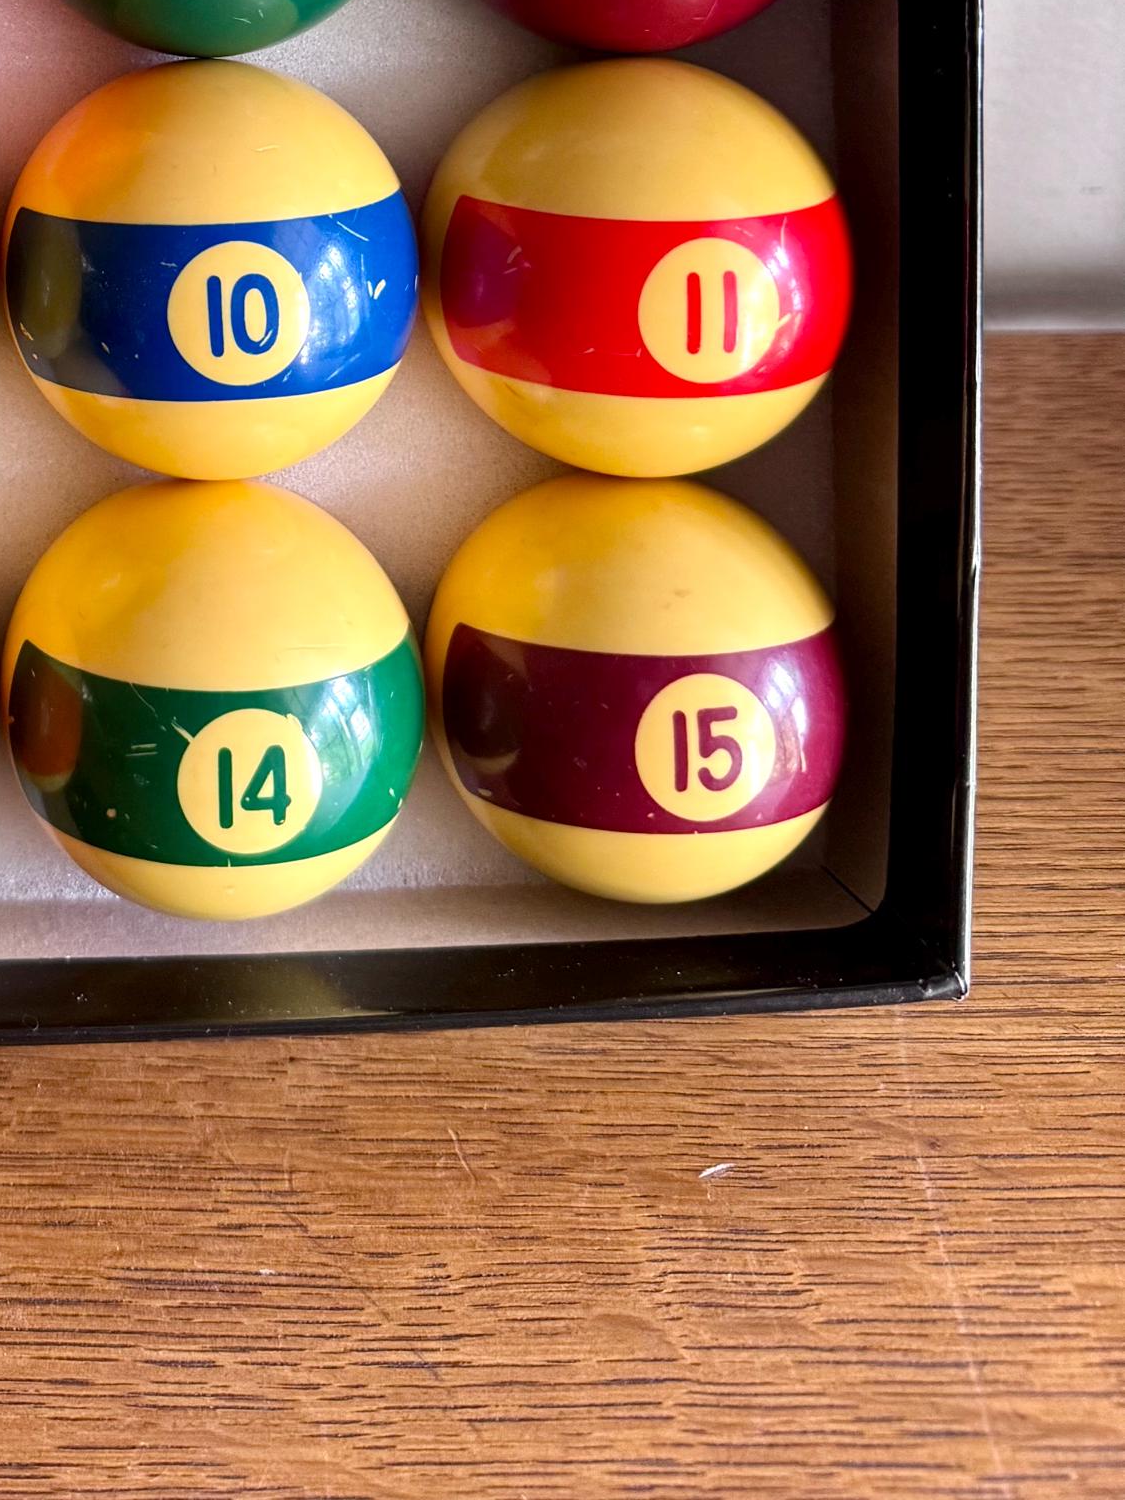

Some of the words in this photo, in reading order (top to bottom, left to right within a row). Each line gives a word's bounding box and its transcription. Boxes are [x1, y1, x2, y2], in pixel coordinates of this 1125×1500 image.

[206, 272, 280, 357] 10
[685, 270, 737, 354] 11
[217, 745, 292, 829] 14
[673, 706, 741, 791] 15
